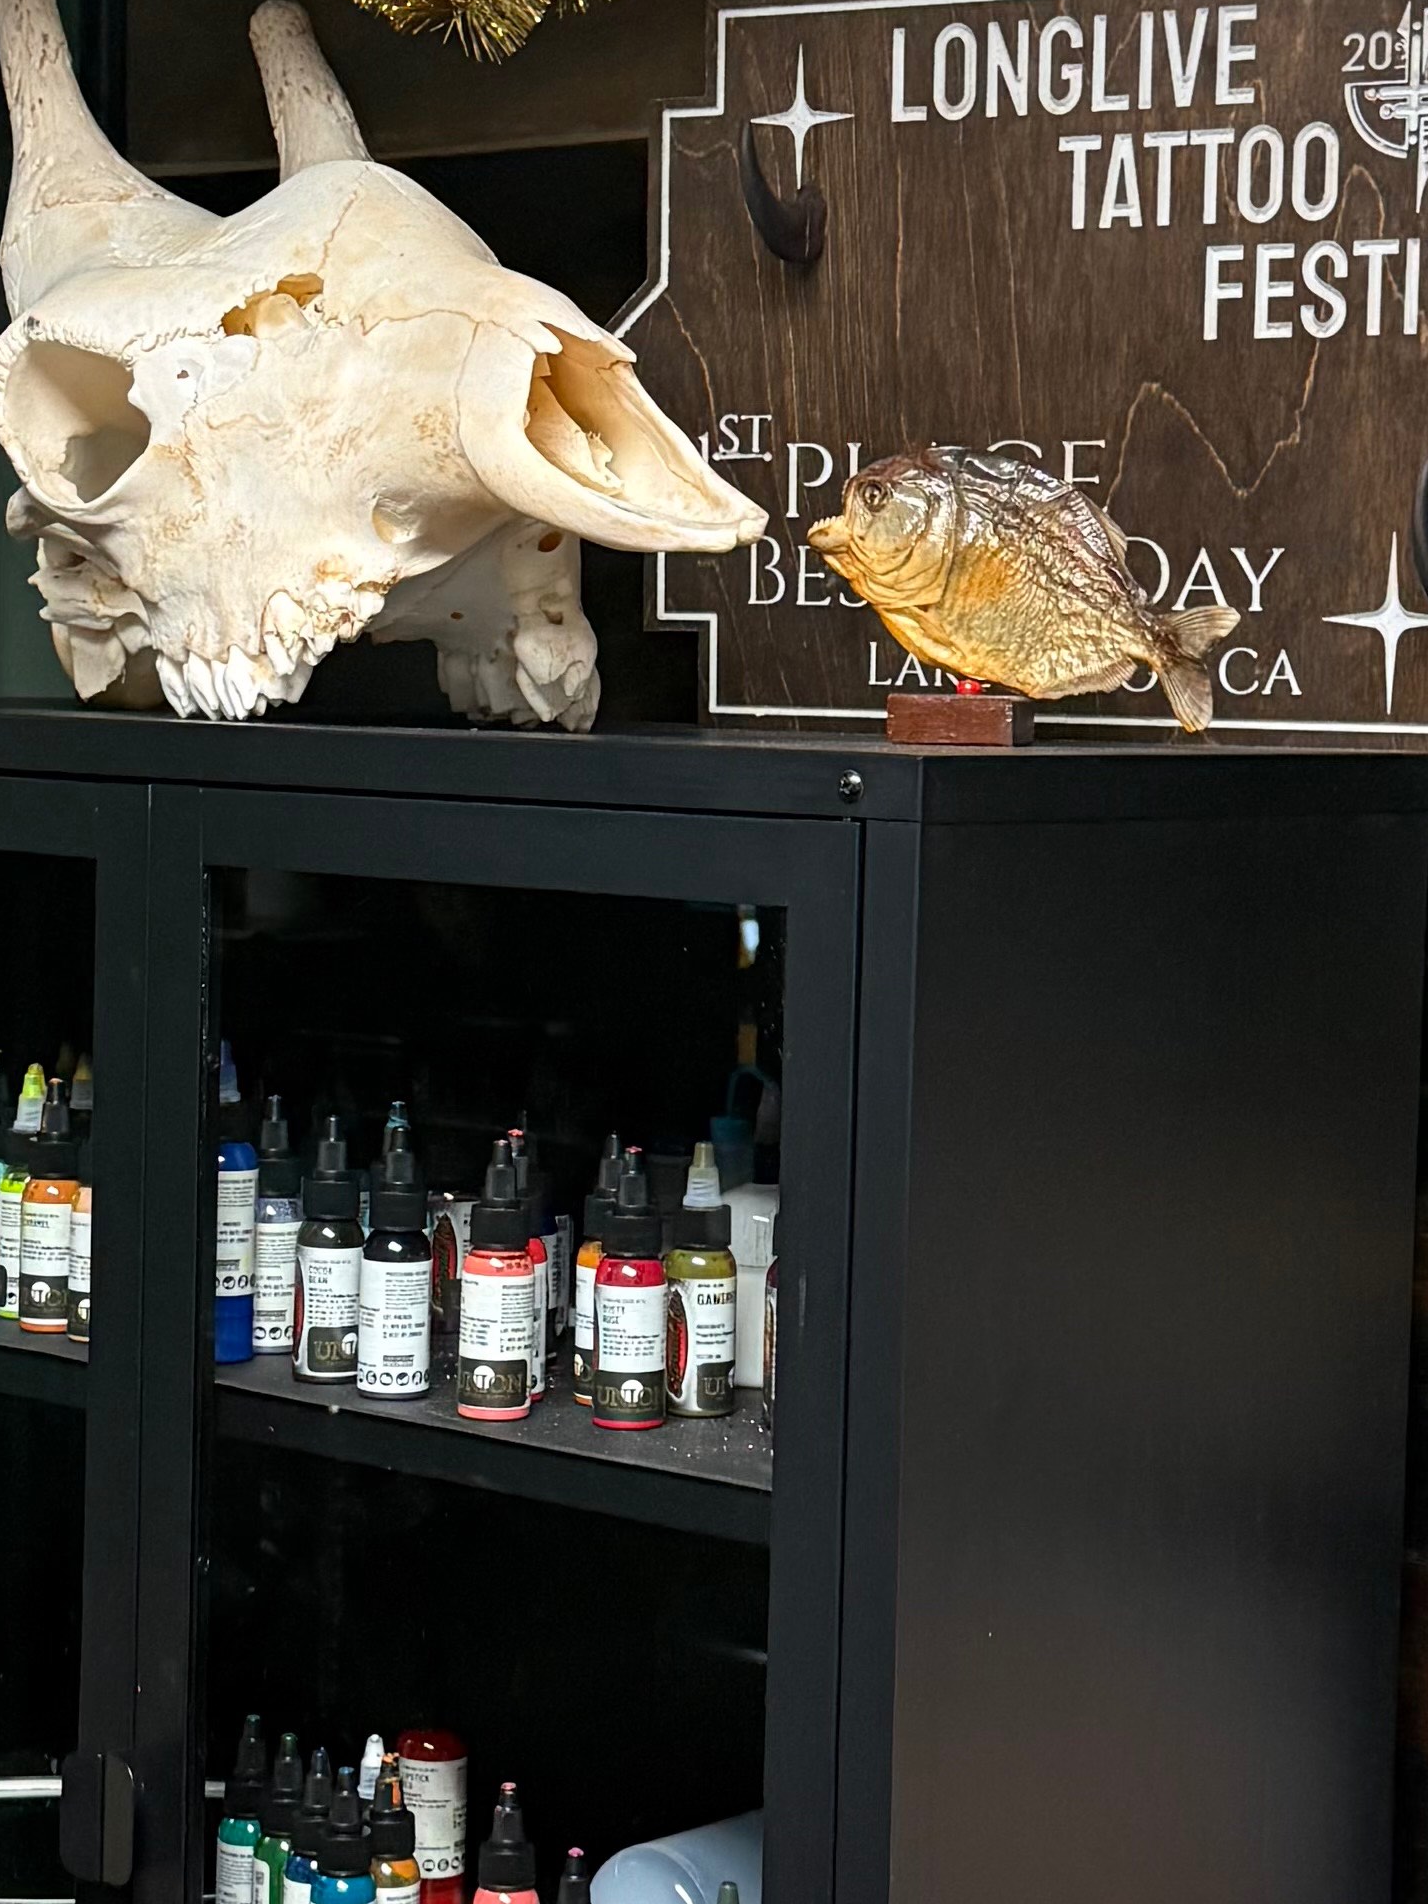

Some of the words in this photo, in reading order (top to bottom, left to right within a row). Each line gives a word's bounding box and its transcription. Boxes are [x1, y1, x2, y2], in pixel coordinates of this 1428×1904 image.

[891, 4, 1257, 123] LONGLIVE
[1341, 31, 1392, 72] 20
[1059, 121, 1340, 230] TATTOO
[1218, 647, 1303, 696] CA
